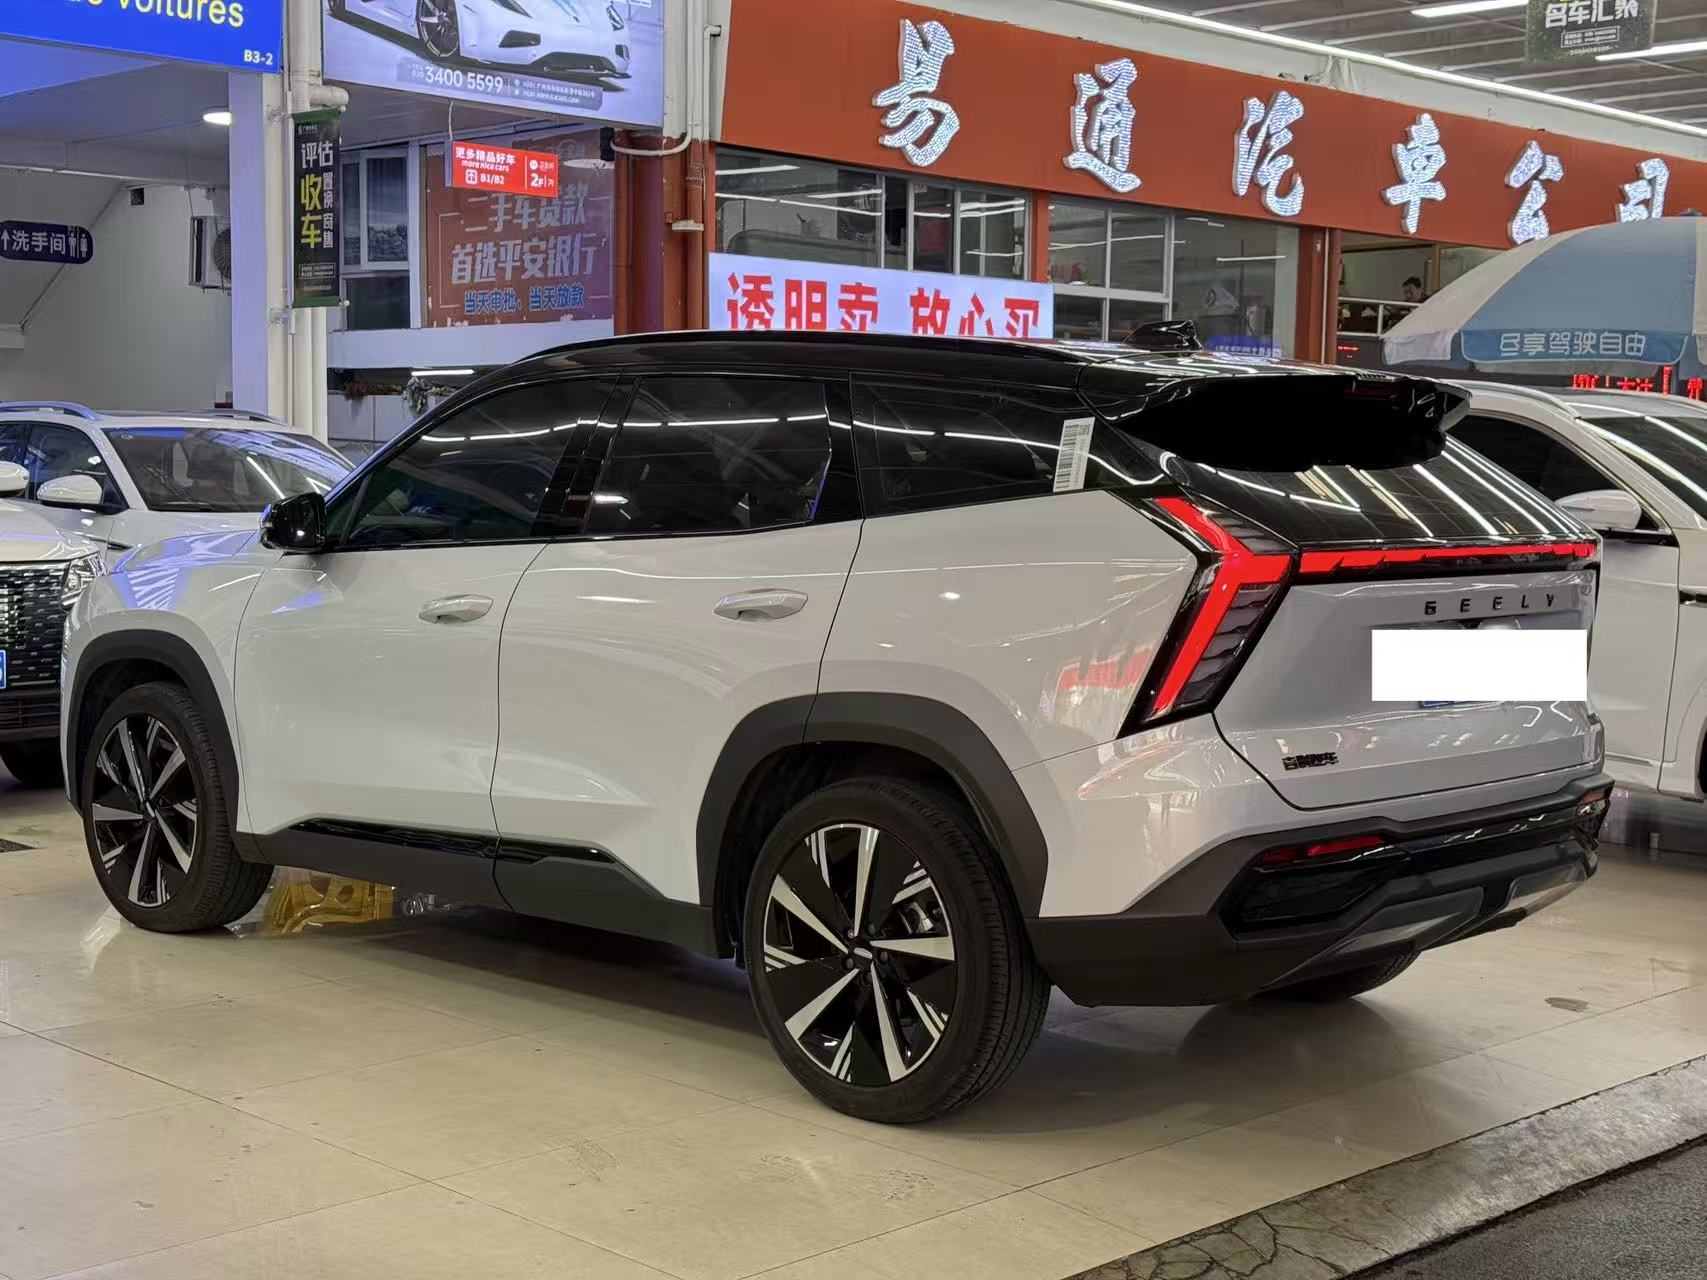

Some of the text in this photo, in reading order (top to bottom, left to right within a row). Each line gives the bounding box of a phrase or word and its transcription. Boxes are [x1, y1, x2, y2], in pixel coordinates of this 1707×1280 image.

[243, 49, 274, 66] B3-2
[425, 66, 463, 87] 3400
[466, 71, 504, 94] 5599
[301, 140, 334, 169] 评估
[455, 146, 516, 165] 更多精品好车
[461, 159, 510, 173] more nice cars
[480, 172, 505, 185] B1/B2
[301, 173, 322, 249] 收车
[12, 229, 66, 255] 洗手间
[451, 232, 598, 285] 首选平安银行
[1499, 331, 1647, 357] 尽享驾驶自由
[1424, 593, 1555, 616] GEELY
